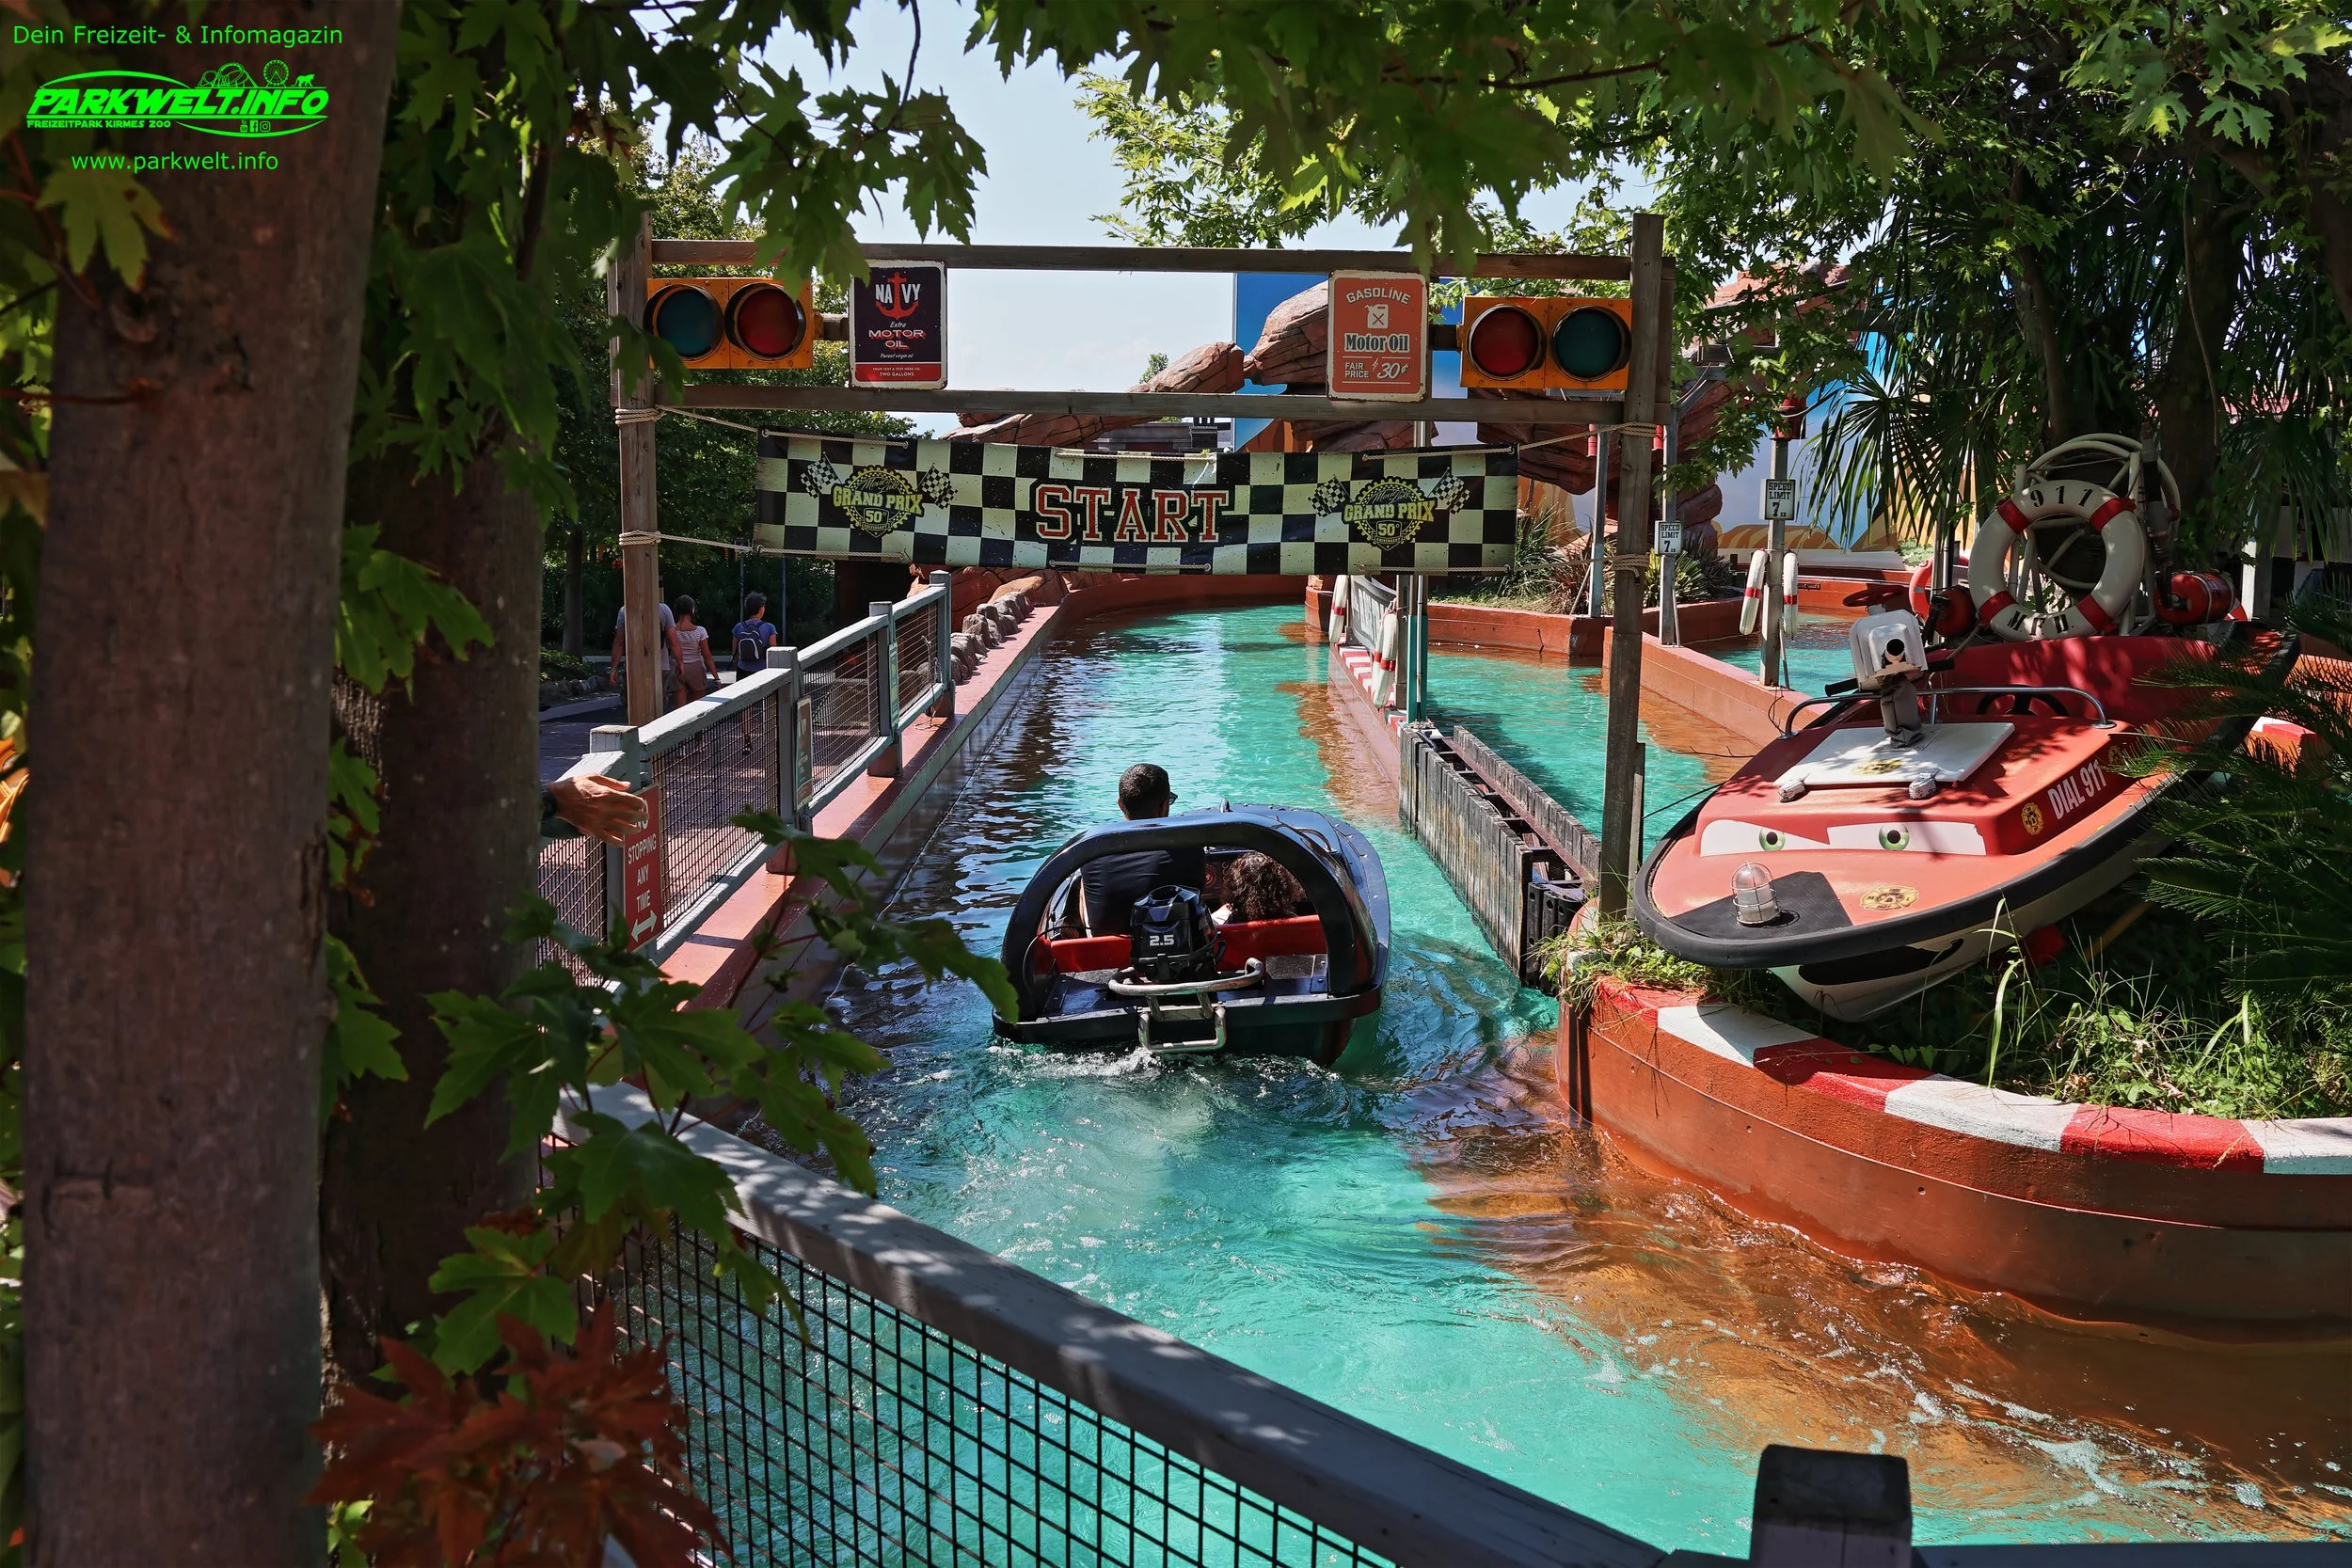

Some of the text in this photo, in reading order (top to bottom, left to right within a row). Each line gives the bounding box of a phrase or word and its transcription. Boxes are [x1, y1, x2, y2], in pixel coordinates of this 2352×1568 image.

[876, 284, 921, 303] NAVY
[1346, 287, 1411, 305] GASOLINE
[868, 329, 925, 339] MOTOR
[1345, 334, 1409, 351] Motor Oil
[885, 340, 909, 348] OIL
[1345, 362, 1363, 371] FAIR
[1345, 370, 1369, 378] PRICE
[1769, 483, 1791, 491] SPEED
[1769, 491, 1790, 499] LIMIT
[833, 485, 922, 515] GRAND PRIX
[2030, 486, 2092, 508] 911
[1036, 483, 1229, 543] START
[1343, 499, 1435, 522] GRAND PRIX
[1772, 502, 1780, 516] 7
[1664, 540, 1671, 552] 7
[2047, 759, 2106, 819] DIAL 911
[628, 833, 657, 865] STOPPING
[637, 863, 649, 887] ANY
[636, 890, 651, 912] TIME
[1150, 934, 1174, 946] 2.5
